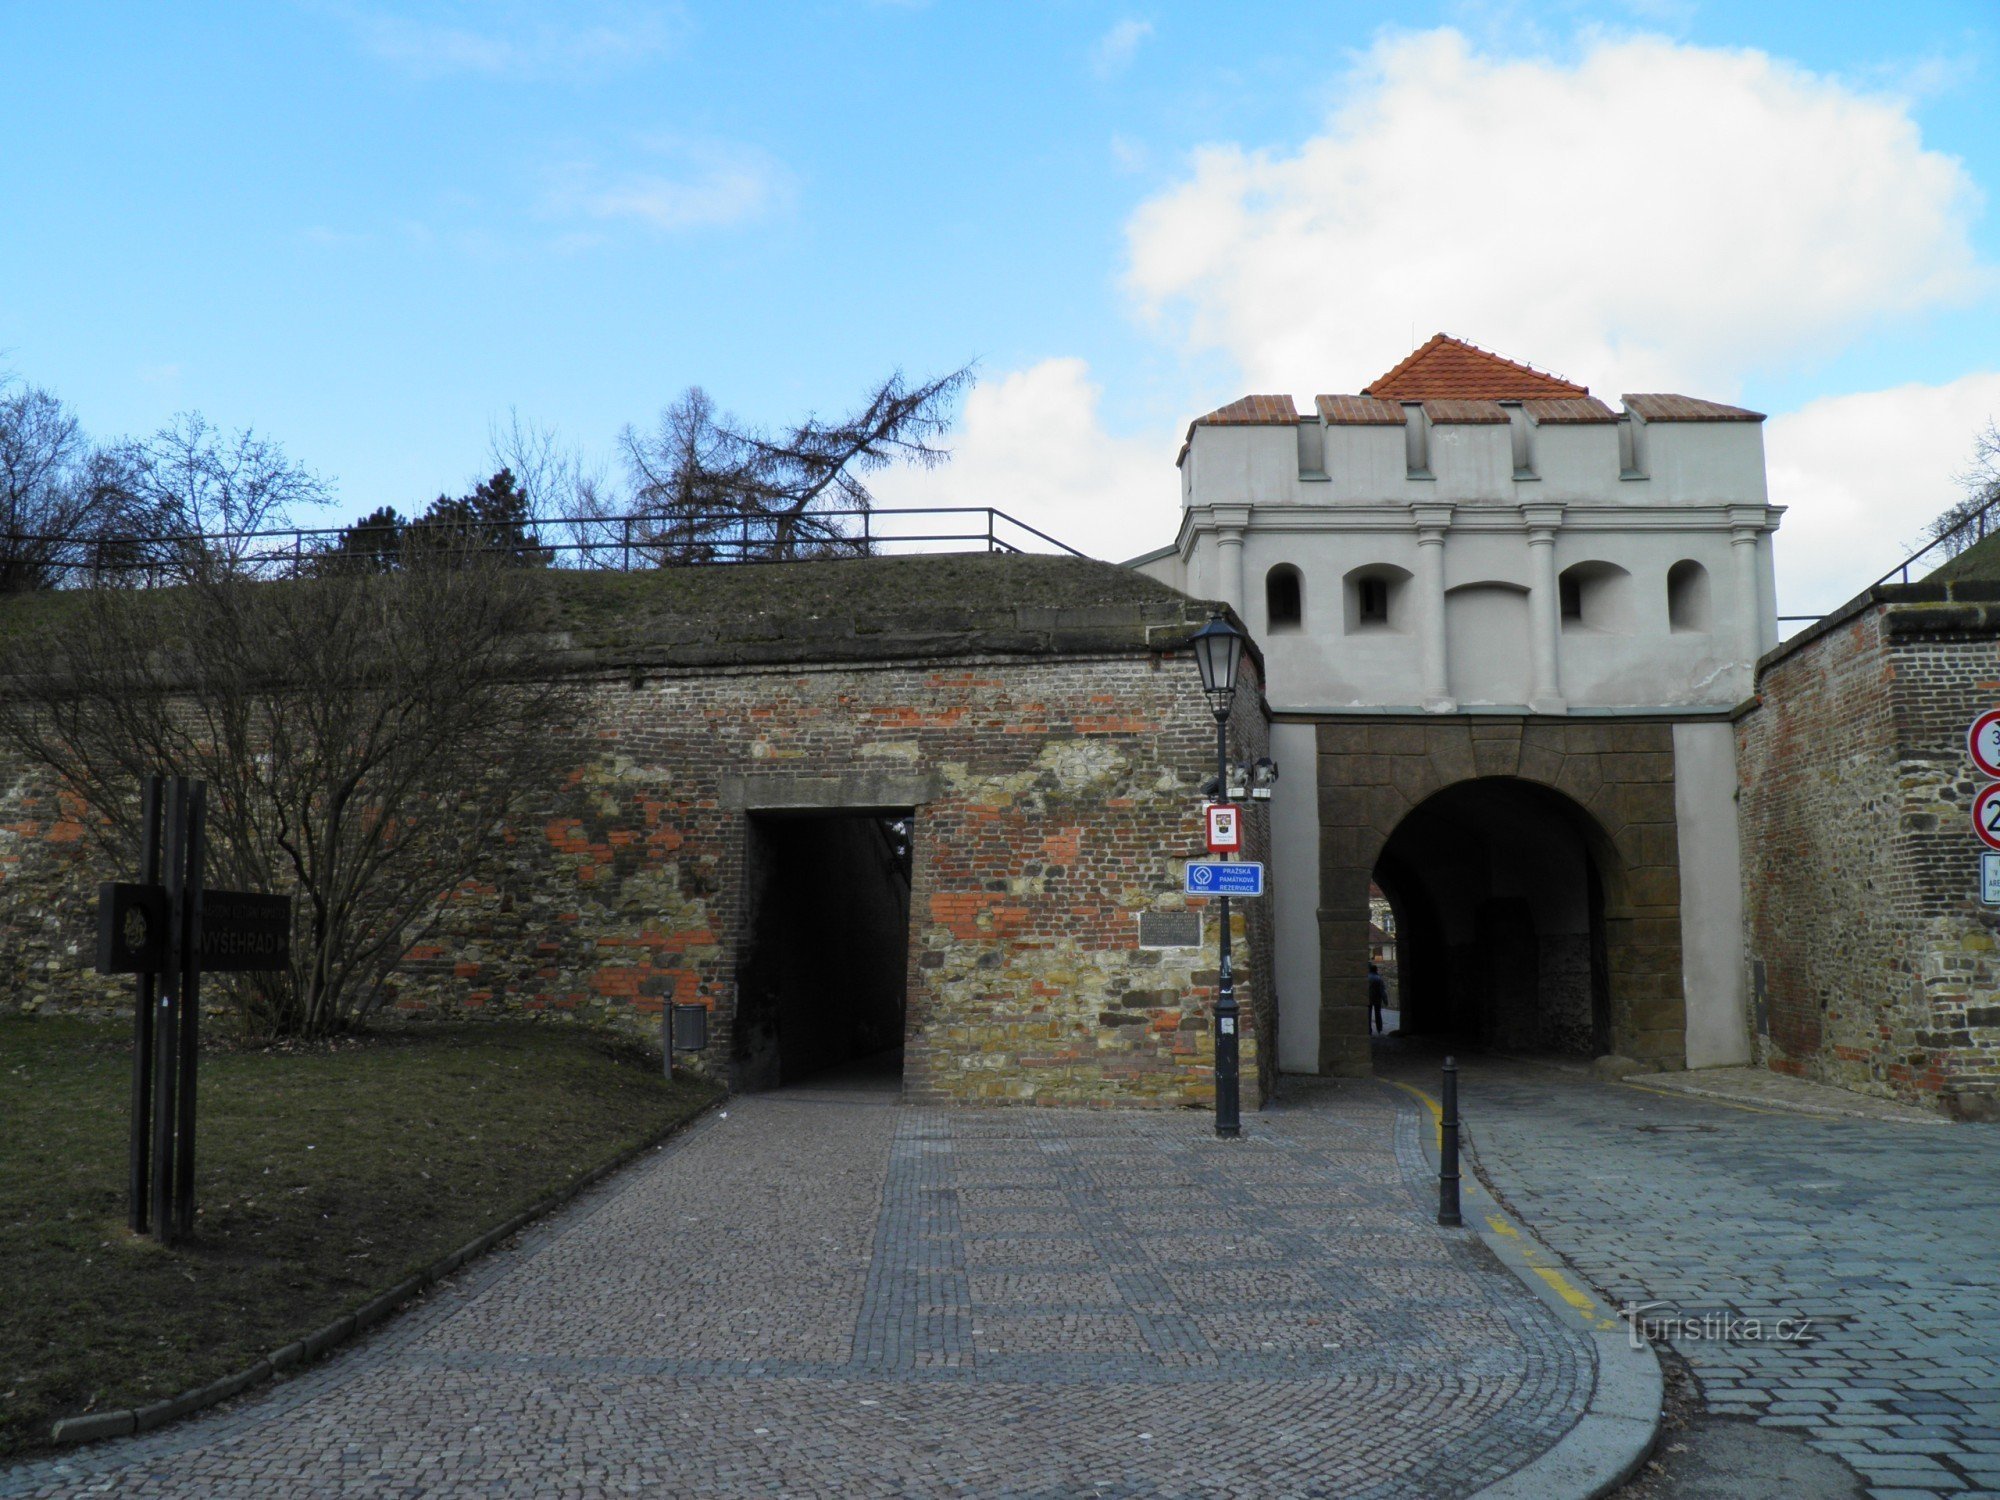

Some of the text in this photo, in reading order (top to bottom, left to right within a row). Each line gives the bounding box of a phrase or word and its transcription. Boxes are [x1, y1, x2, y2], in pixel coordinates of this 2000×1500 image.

[1986, 799, 2000, 832] 2
[1219, 884, 1254, 892] REZERVACE
[202, 927, 274, 955] VYŠEHRAD
